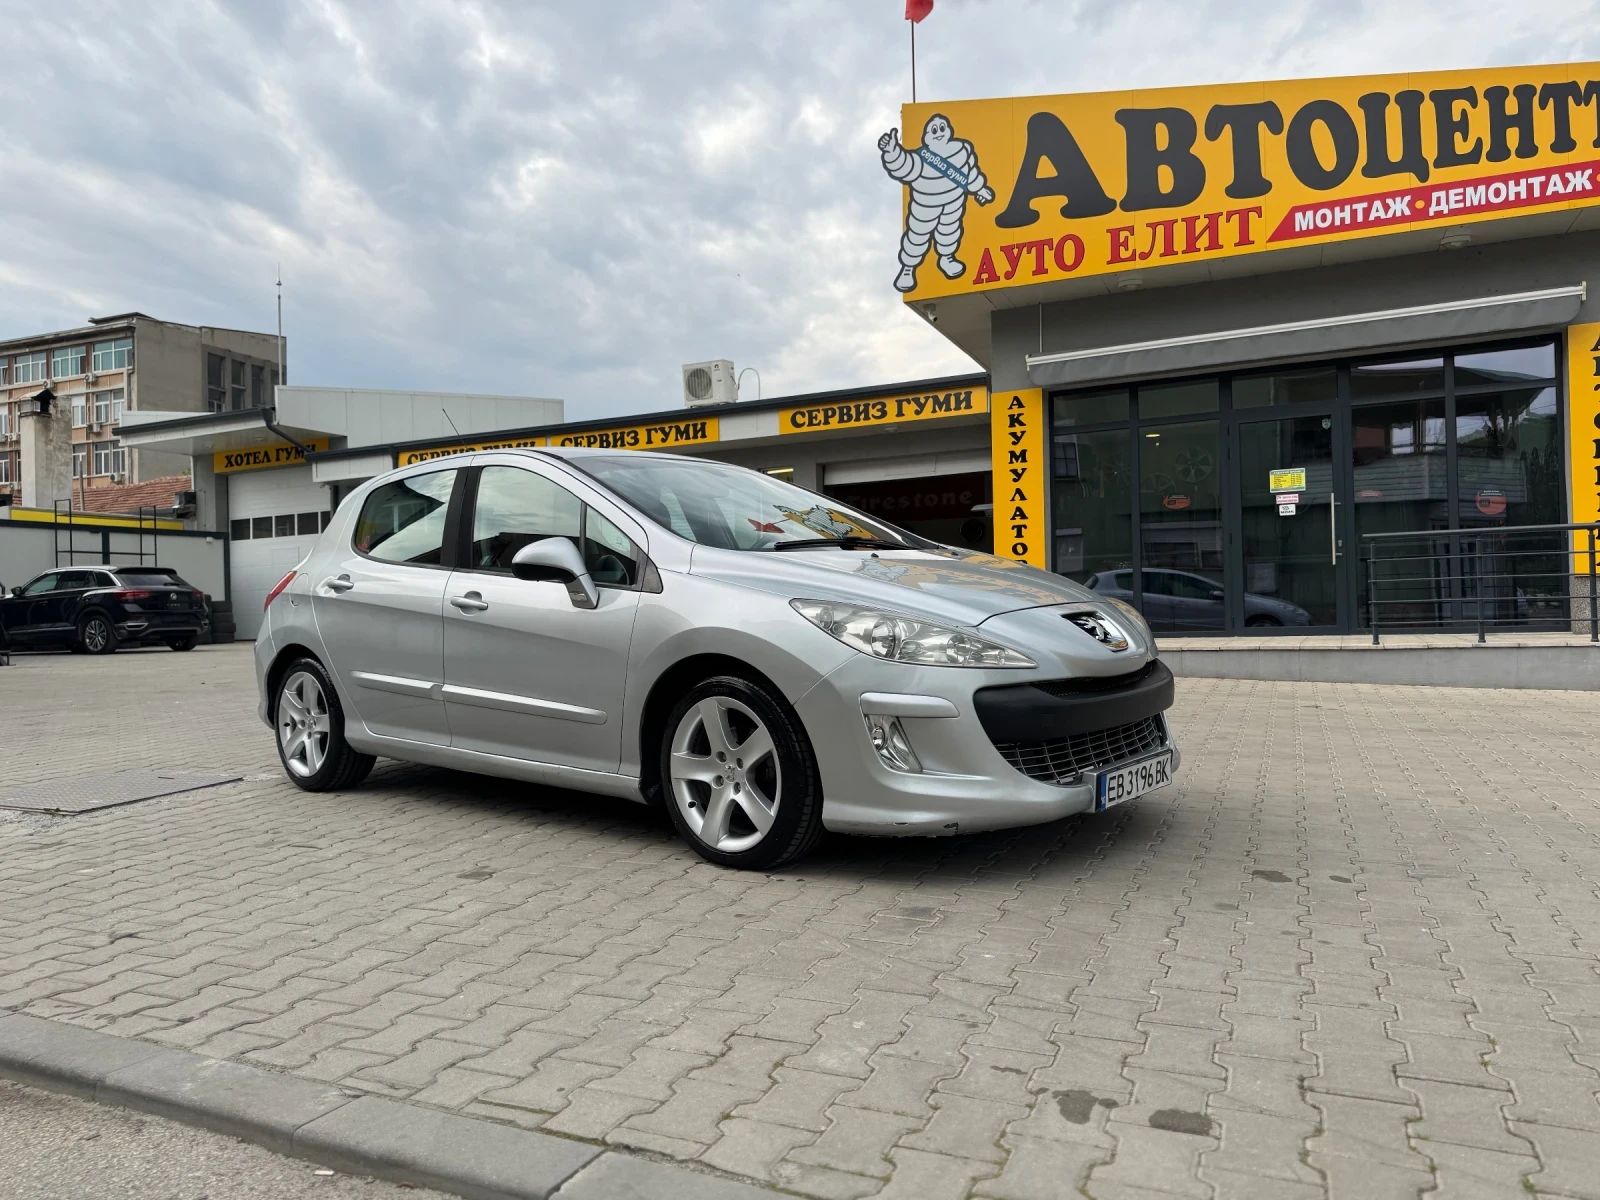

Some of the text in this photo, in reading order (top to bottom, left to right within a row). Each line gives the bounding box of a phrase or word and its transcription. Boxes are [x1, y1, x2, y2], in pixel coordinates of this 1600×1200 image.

[921, 149, 967, 185] сервиз гуми
[1294, 169, 1593, 232] МОНТАЖ ДЕМОНТАЖ
[973, 206, 1263, 285] АУТО ЕЛИТ
[790, 391, 972, 428] СЕРВИЗ ГУМИ
[645, 422, 708, 445] ГУМИ
[224, 450, 271, 468] ХОТЕЛ
[1007, 395, 1029, 565] АКУМУЛАТО
